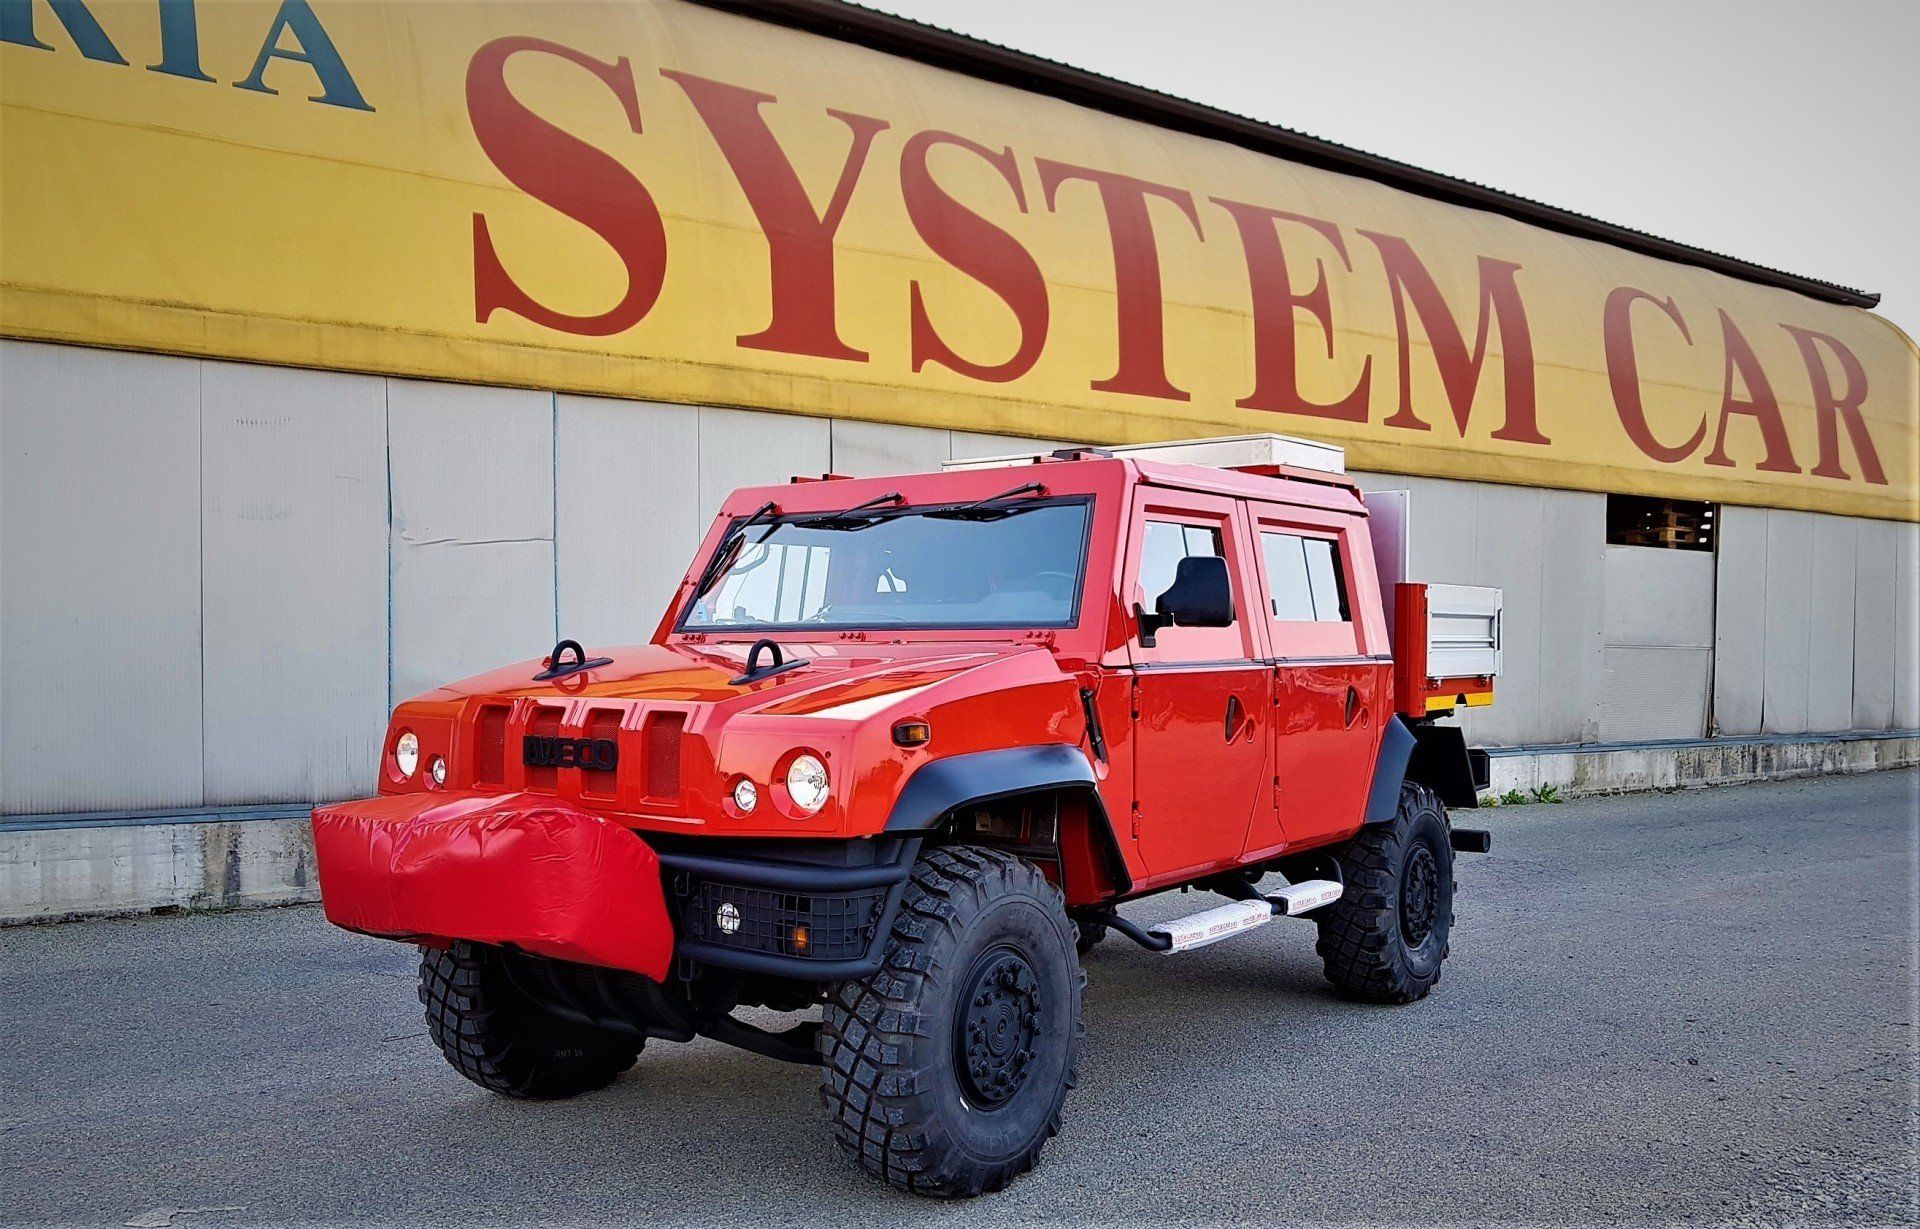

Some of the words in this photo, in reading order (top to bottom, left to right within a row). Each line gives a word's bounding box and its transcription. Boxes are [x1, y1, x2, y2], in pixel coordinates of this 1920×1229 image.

[465, 35, 1552, 444] SYSTEM
[1603, 285, 1888, 485] CAR
[523, 735, 619, 770] IVECO
